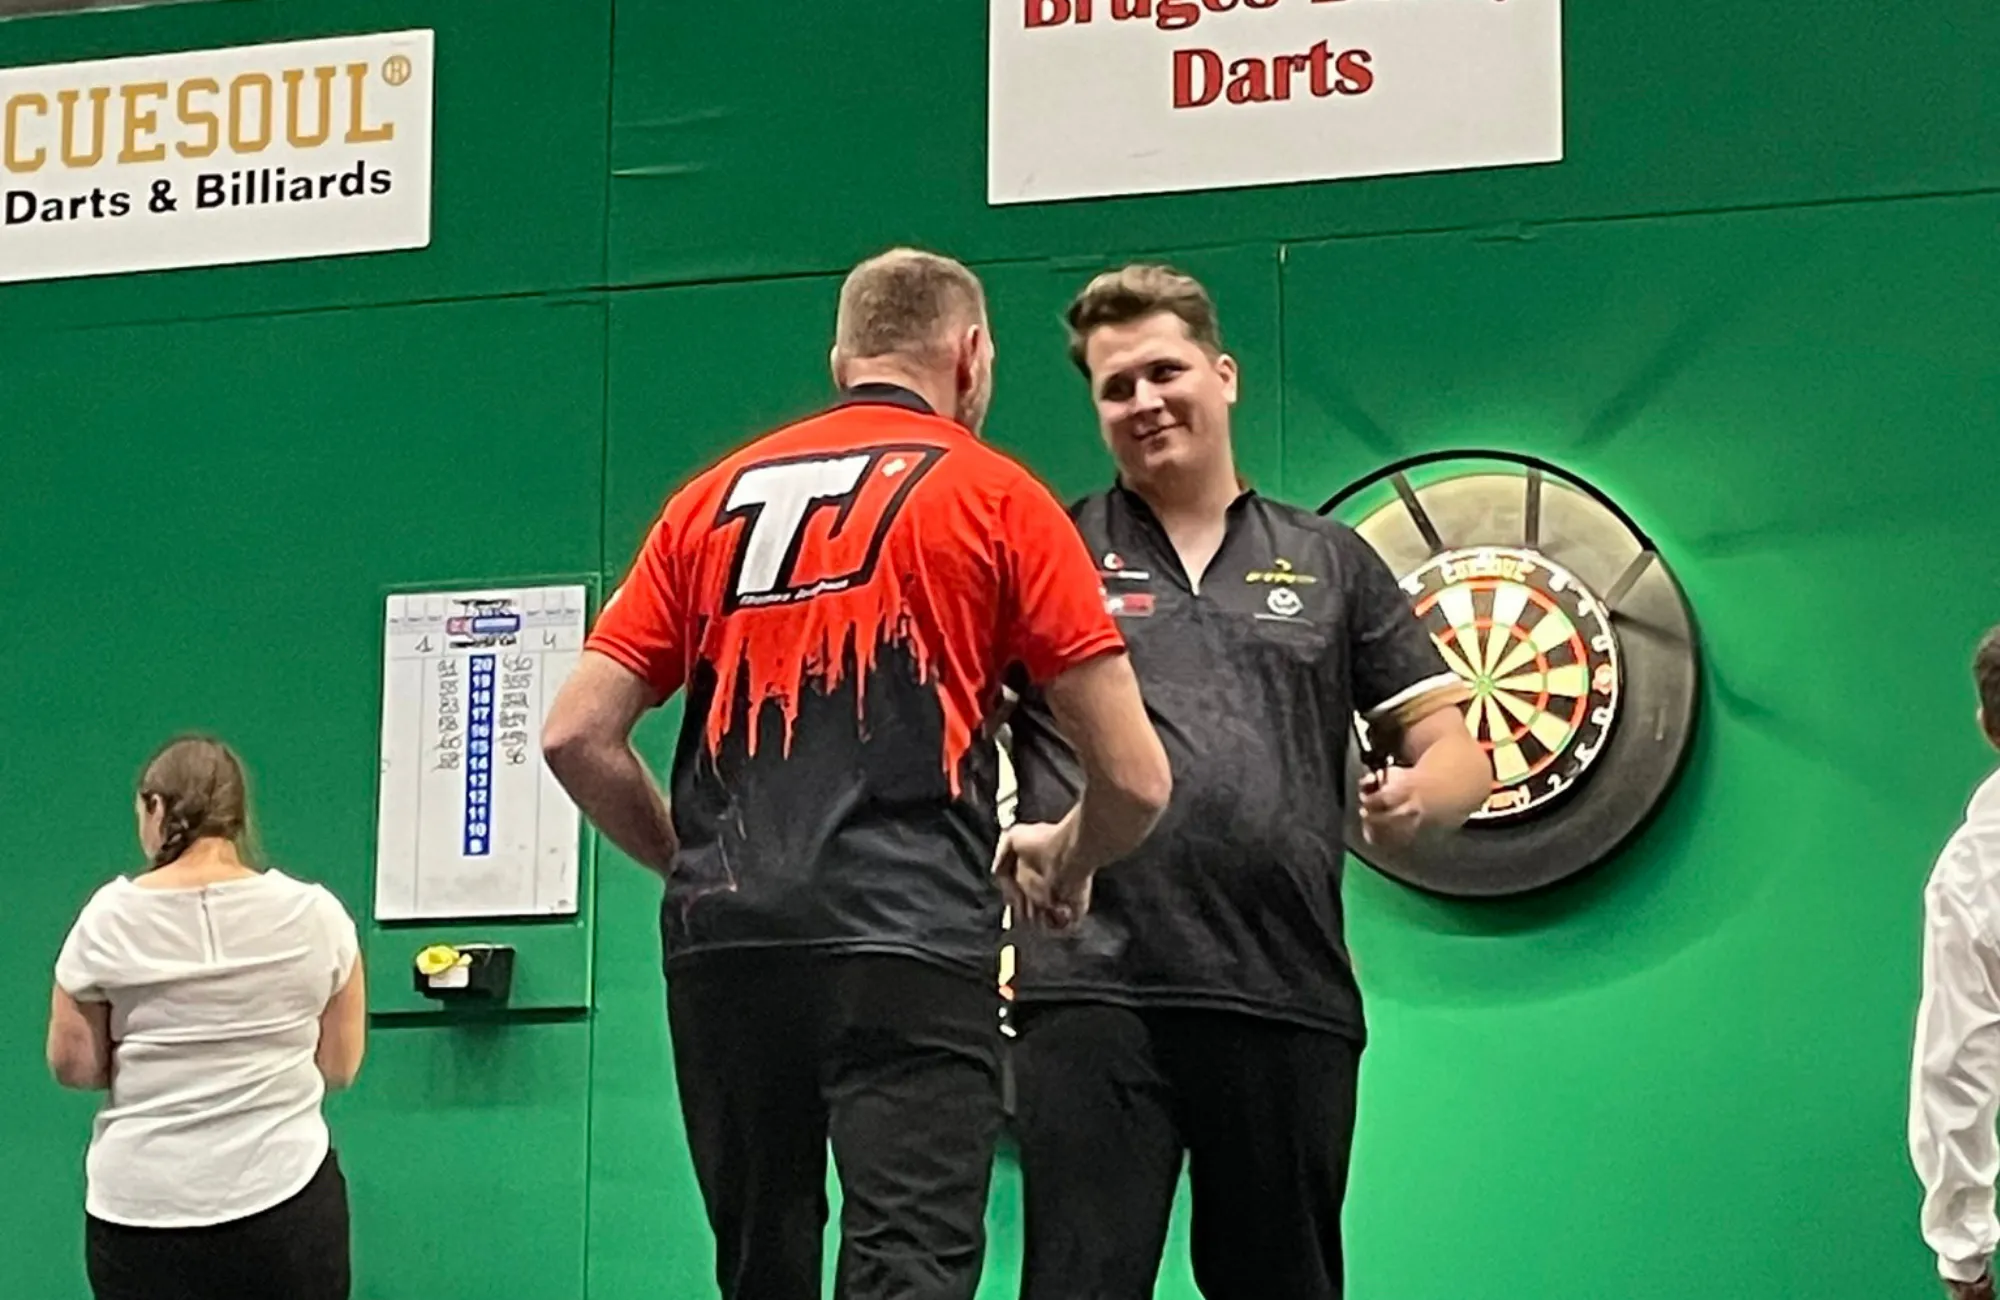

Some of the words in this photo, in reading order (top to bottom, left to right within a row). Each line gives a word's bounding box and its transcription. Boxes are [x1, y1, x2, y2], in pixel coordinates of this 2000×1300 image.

[1172, 40, 1374, 109] Darts
[4, 187, 131, 225] Darts
[148, 179, 177, 213] &
[195, 160, 393, 210] Billiards
[472, 658, 493, 672] 20
[472, 706, 490, 720] 17
[469, 756, 488, 770] 14
[468, 789, 487, 804] 12
[468, 823, 487, 837] 10
